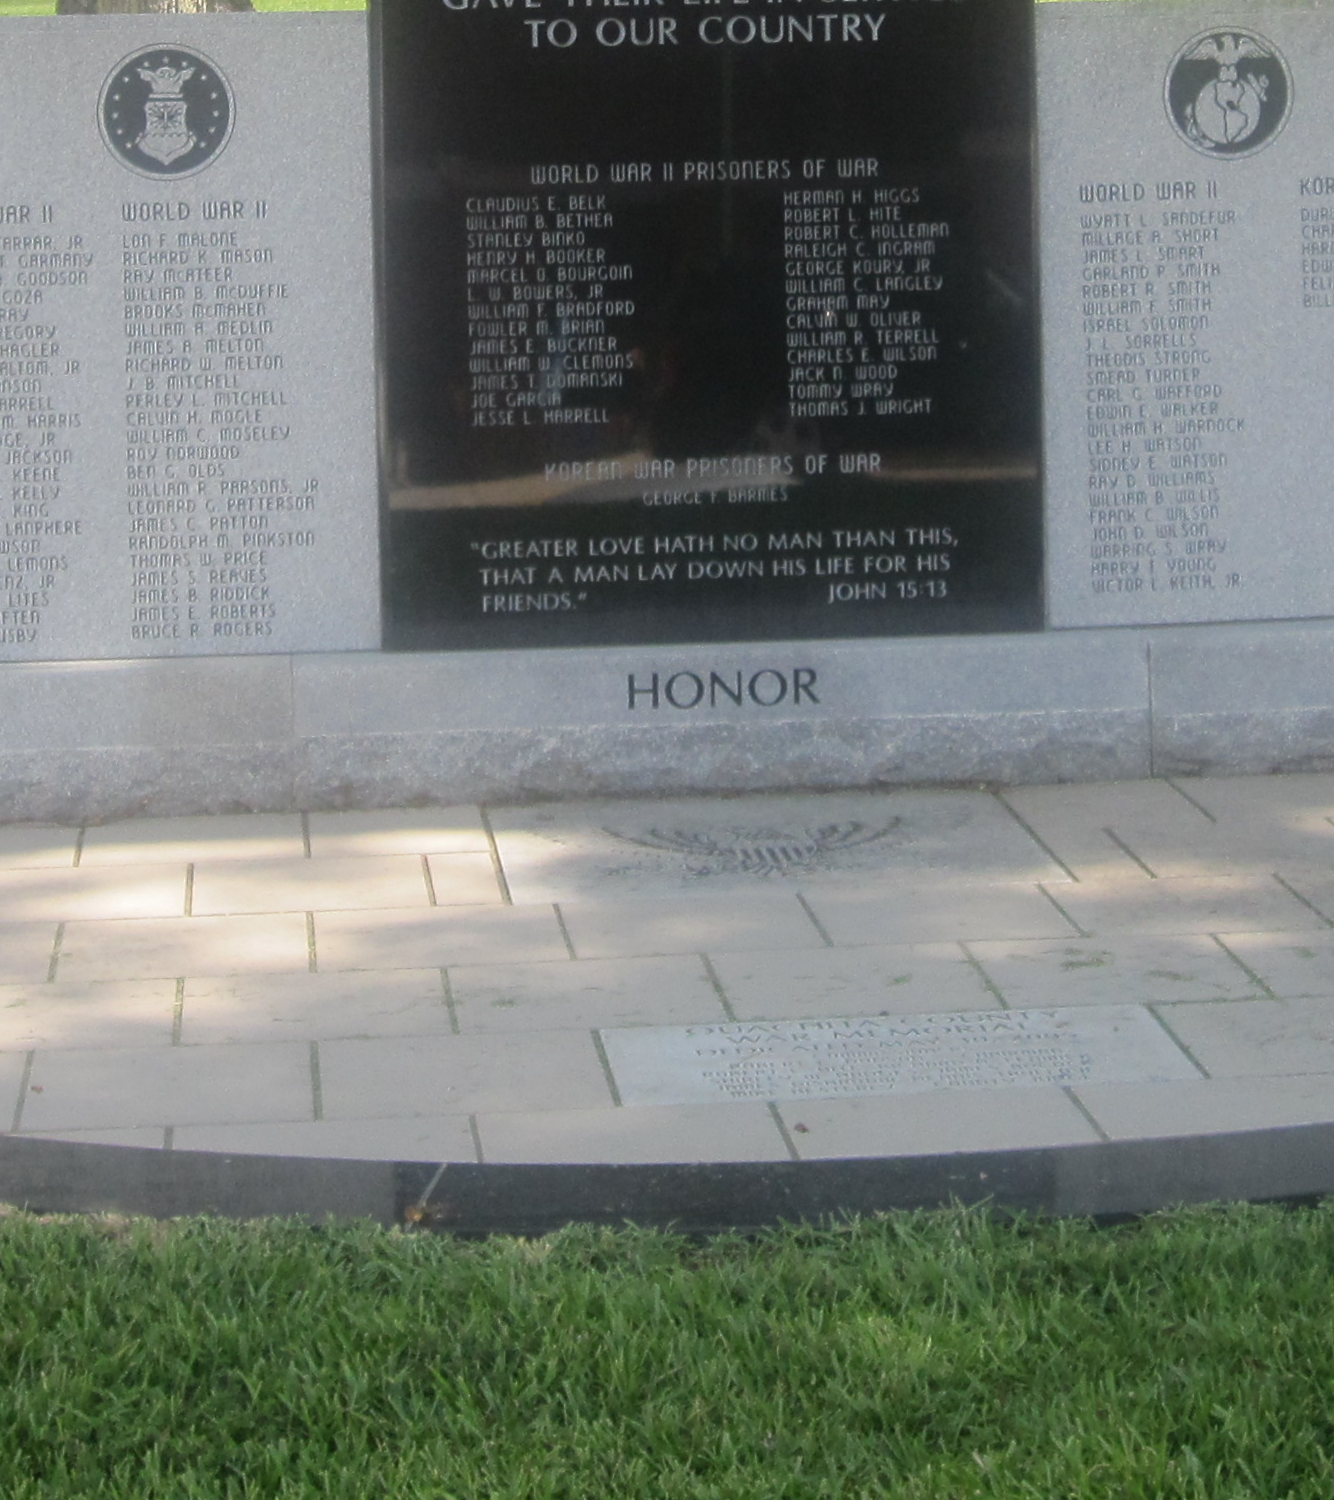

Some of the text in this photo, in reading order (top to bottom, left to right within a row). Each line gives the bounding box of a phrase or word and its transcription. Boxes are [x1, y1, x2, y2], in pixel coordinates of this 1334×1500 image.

[524, 13, 885, 48] TO OUR COUNTRY
[531, 159, 879, 184] WORLD WAR II PRISONERS OF WAR
[784, 188, 920, 205] HERMAN HIGGS
[1079, 181, 1218, 201] WORLD WAR II
[122, 201, 267, 222] WORLD WAR II
[467, 197, 539, 213] CLAUDIUS
[568, 195, 606, 210] BELK
[42, 205, 53, 223] II
[467, 214, 528, 230] WILLIAM
[557, 213, 613, 228] BETHEA
[784, 207, 839, 223] ROBERT
[869, 206, 901, 221] HITE
[467, 231, 585, 248] STANLEY BINKO
[785, 225, 840, 241] ROBERT
[871, 222, 949, 238] HOLLEMAN
[123, 248, 273, 266] RICHARD MASON
[467, 249, 605, 266] HENRY BOOKER
[785, 241, 936, 258] RALEIGH INGRAM
[467, 265, 633, 283] MARCEL BOURGOIN
[785, 260, 845, 276] GEORGE
[1083, 261, 1221, 281] GARLAND SMITH
[785, 276, 943, 294] WILLIAM LANGLEY
[469, 301, 635, 318] WILLIAM BRADFORD
[789, 399, 932, 416] THOMAS WRIGHT
[545, 454, 881, 481] KOREAN WAR PRISONERS OF WAR
[643, 490, 703, 506] GEORGE
[589, 537, 645, 557] LOVE
[654, 536, 714, 555] HATH
[723, 534, 758, 553] NO
[768, 532, 823, 551] MAN
[832, 531, 895, 548] THAN
[906, 528, 959, 549] THIS,
[480, 554, 951, 587] THAT A MAN LAY DOWN HIS LIFE FOR HIS
[828, 580, 947, 604] JOHN 15:13
[628, 668, 821, 710] HONOR
